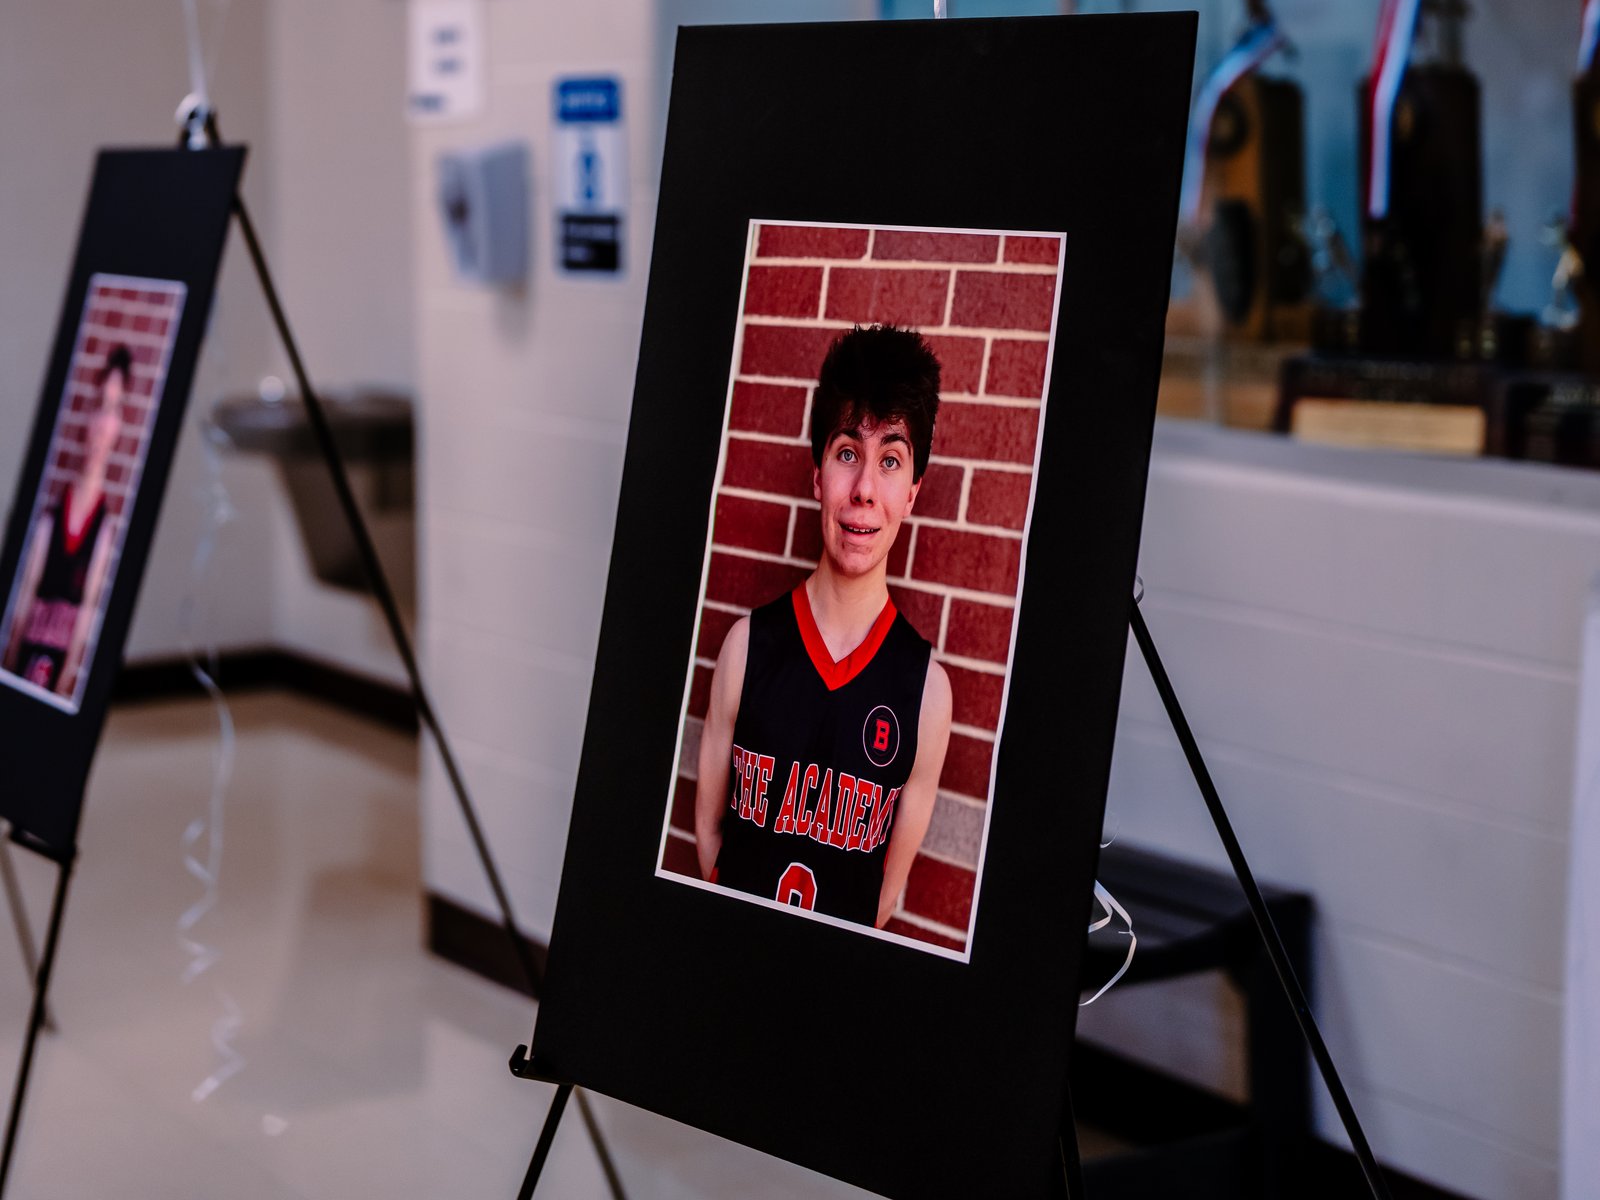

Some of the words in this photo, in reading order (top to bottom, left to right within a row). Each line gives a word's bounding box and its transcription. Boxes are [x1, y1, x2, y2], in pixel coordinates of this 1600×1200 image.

[873, 719, 890, 751] B
[731, 744, 775, 827] THE
[774, 762, 904, 852] ACADEM
